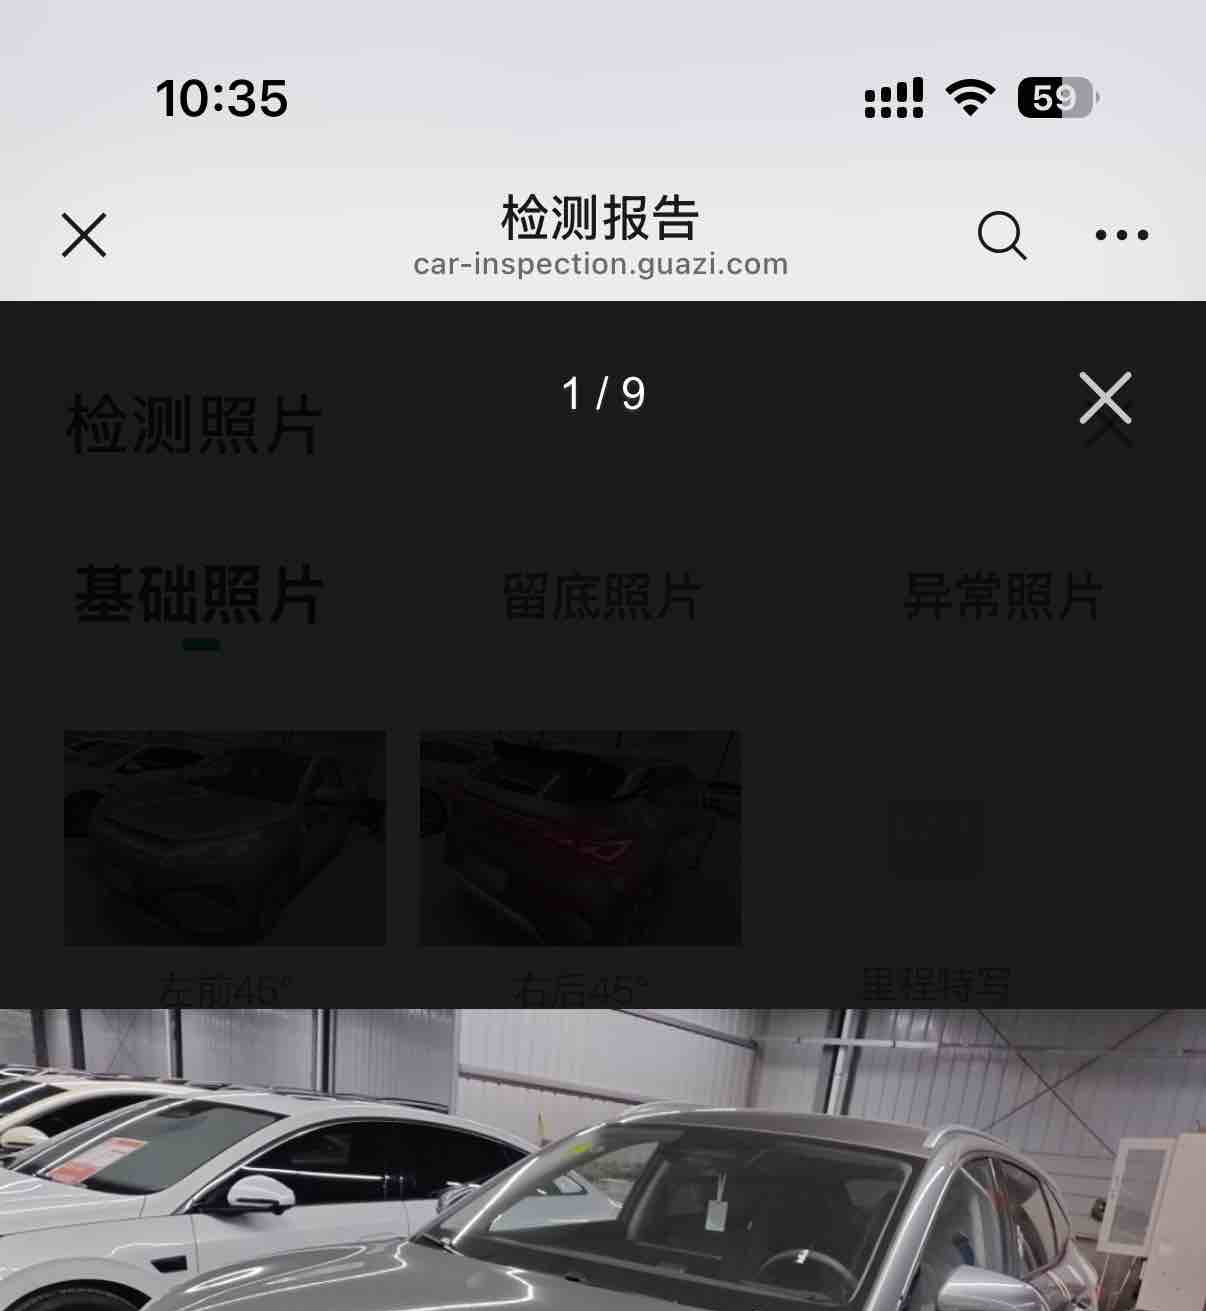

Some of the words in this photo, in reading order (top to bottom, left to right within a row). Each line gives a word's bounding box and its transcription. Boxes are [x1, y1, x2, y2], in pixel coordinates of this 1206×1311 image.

[156, 79, 288, 118] 10:35
[1033, 84, 1076, 111] 59
[500, 193, 700, 241] 检测报告
[413, 250, 788, 281] car-inspection.guazi.com
[562, 376, 577, 410] 1
[622, 376, 645, 411] 9
[65, 392, 322, 456] 检测照片
[73, 562, 325, 625] 基础照片
[502, 570, 704, 622] 留底照片
[904, 570, 1104, 622] 异常照片
